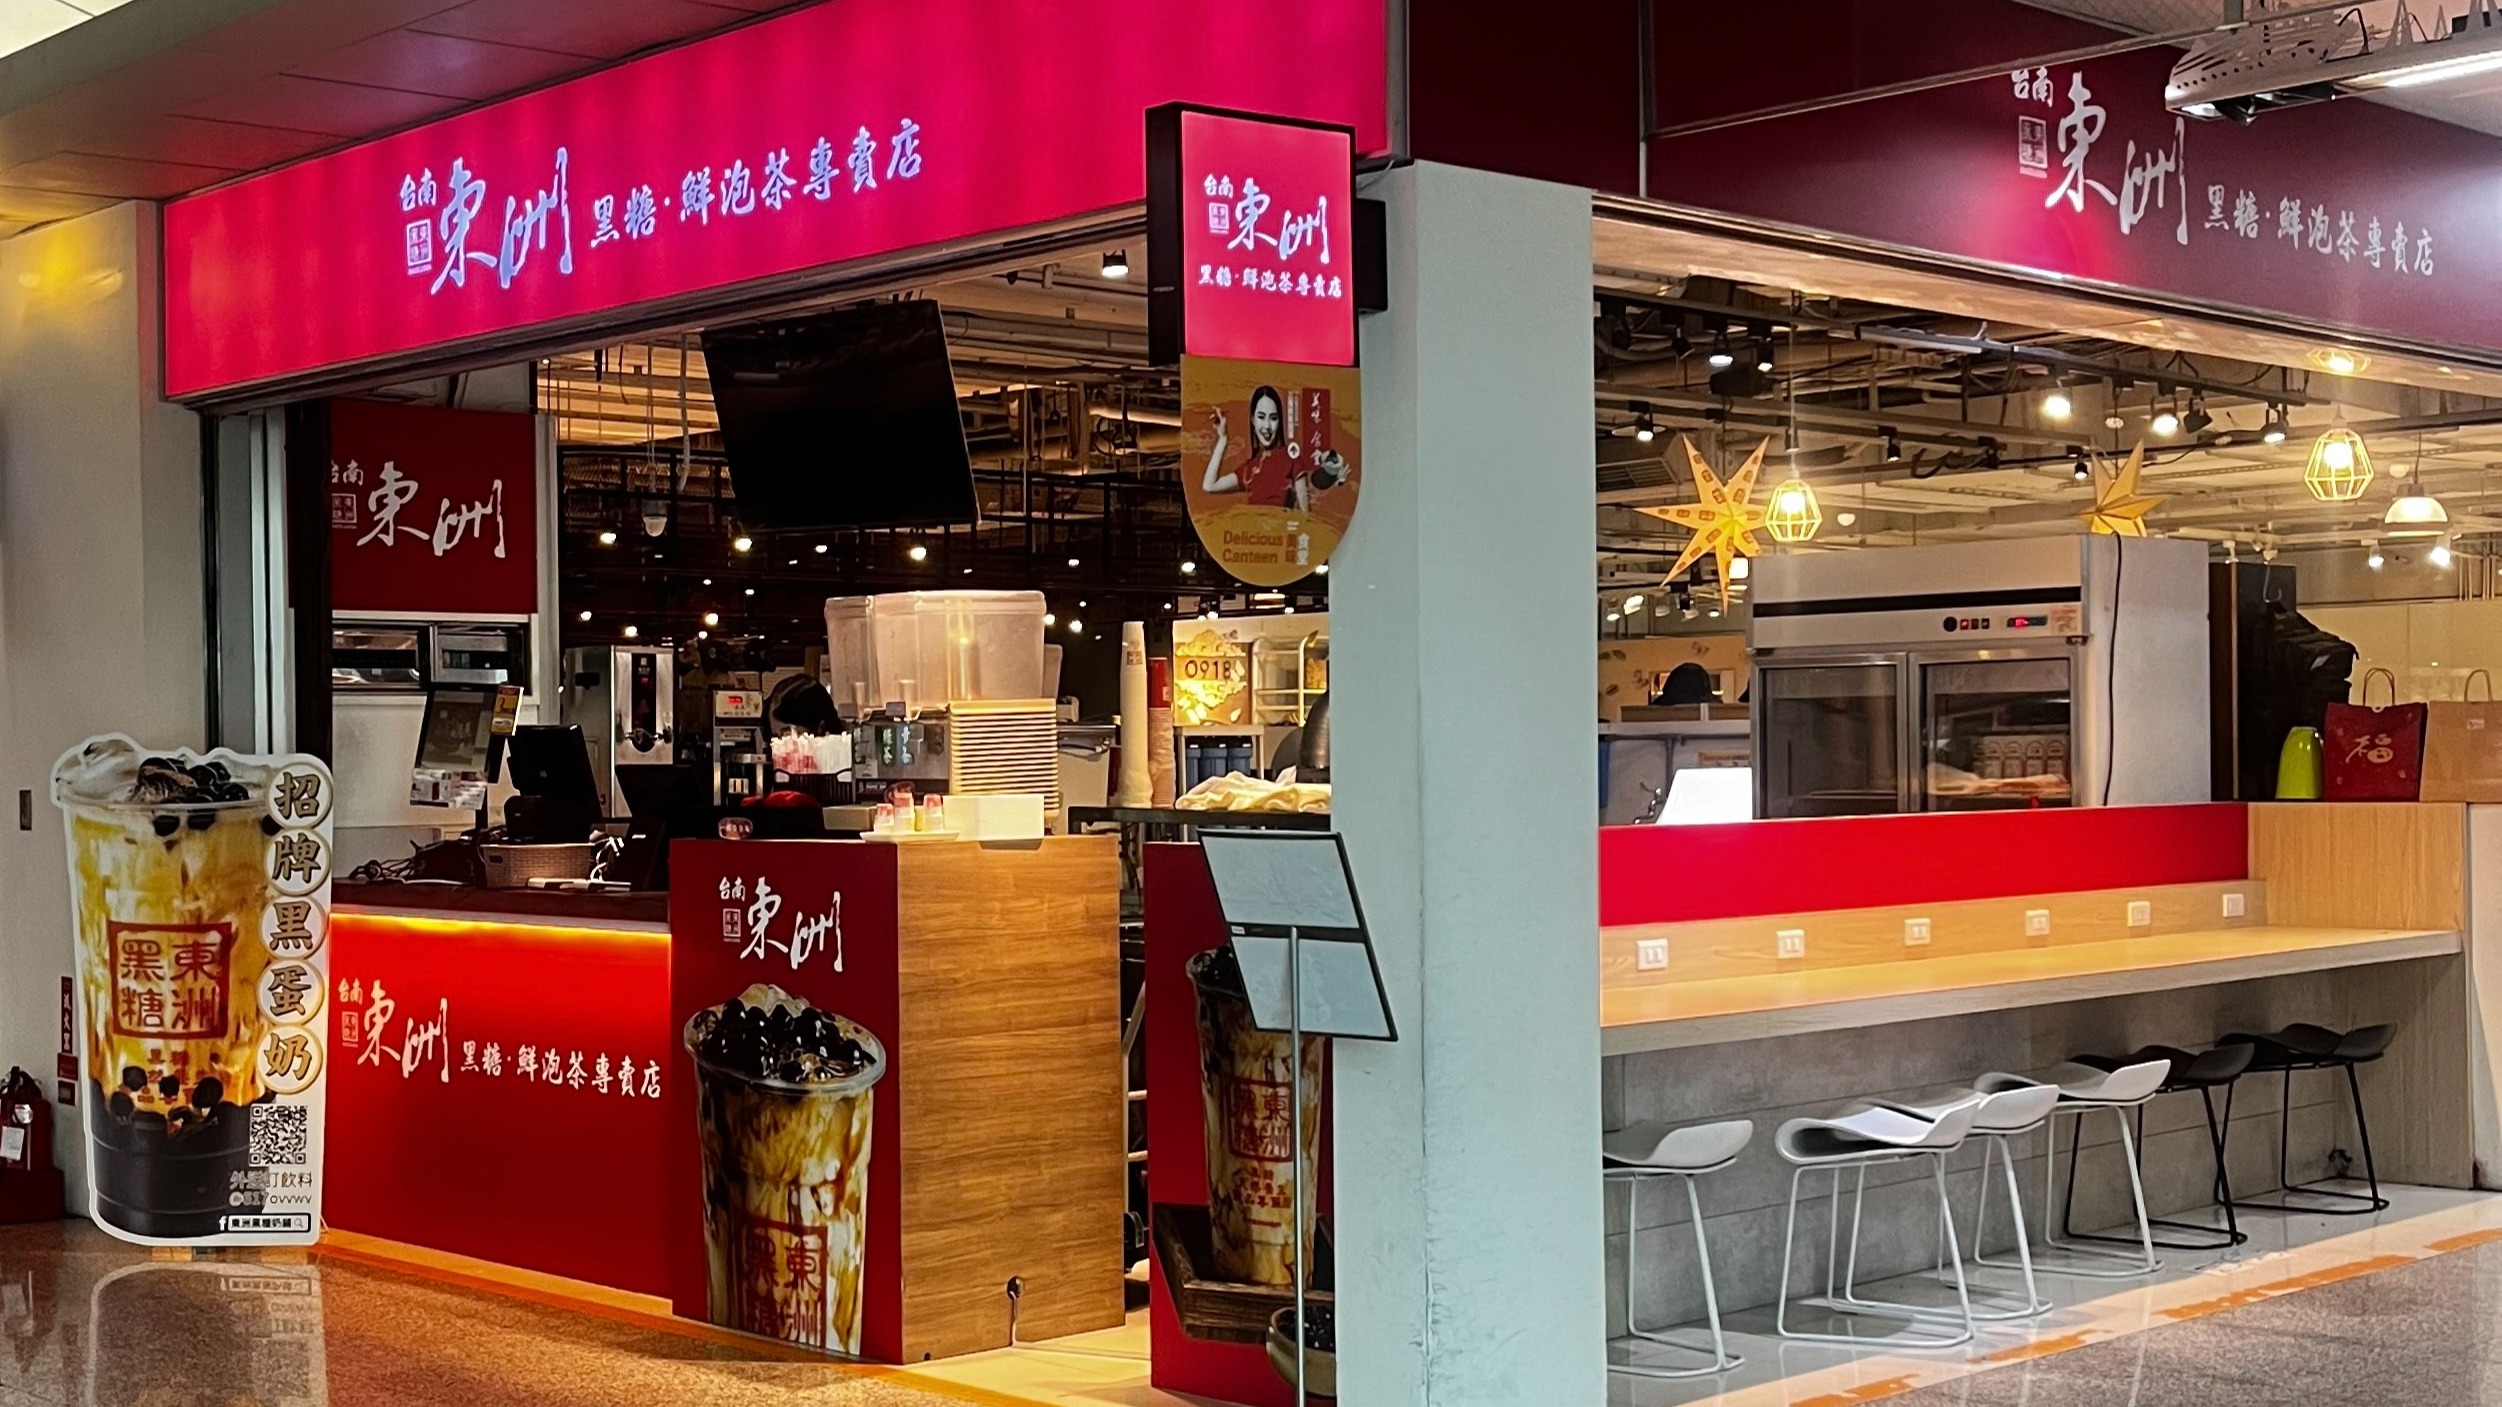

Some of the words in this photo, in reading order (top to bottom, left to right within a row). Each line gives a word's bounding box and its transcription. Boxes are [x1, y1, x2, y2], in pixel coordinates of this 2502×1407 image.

[2011, 67, 2053, 108] 台南
[2045, 71, 2188, 245] 東洲
[400, 168, 437, 212] 台南
[430, 147, 573, 296] 東洲
[590, 118, 922, 248] 黑糖·鮮泡茶專賣店
[1203, 173, 1234, 198] 台南
[1227, 177, 1330, 264] 東洲
[356, 460, 506, 559] 東洲
[1222, 548, 1278, 563] Canteen
[1223, 530, 1284, 546] Delicious
[1184, 659, 1232, 680] 0918
[719, 876, 746, 902] 台南
[263, 770, 323, 1084] 招牌黑蛋奶
[740, 876, 843, 973] 東洲
[338, 977, 364, 1005] 台南
[357, 979, 450, 1083] 東洲
[460, 1040, 662, 1099] 黑糖·鮮泡茶專賣店
